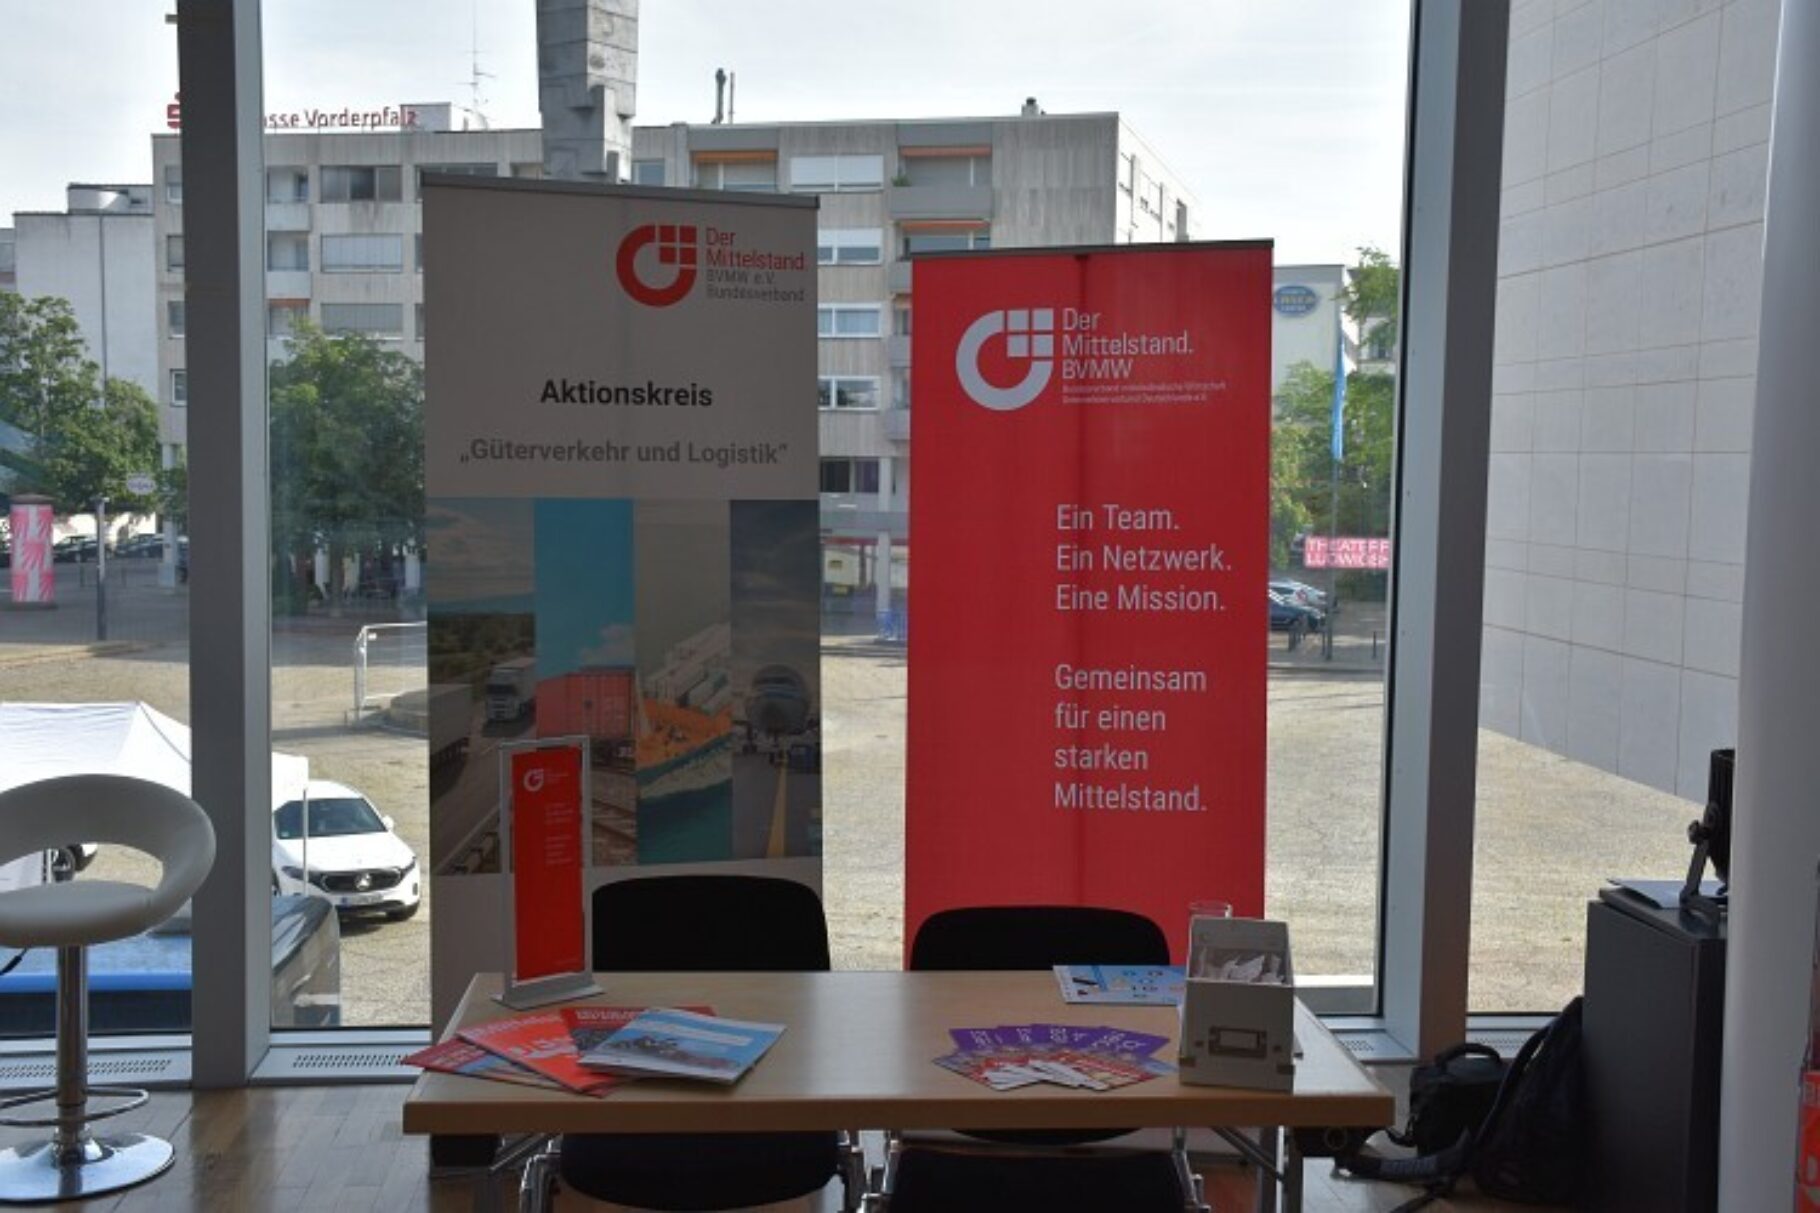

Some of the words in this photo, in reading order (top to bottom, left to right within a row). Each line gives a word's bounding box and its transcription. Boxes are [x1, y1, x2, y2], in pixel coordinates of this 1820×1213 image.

[304, 106, 418, 130] Vorderpfalz
[705, 227, 736, 246] Der
[1062, 307, 1101, 331] Der
[1062, 328, 1195, 357] Mittelstand.
[1062, 358, 1133, 380] BVMW
[541, 378, 713, 406] Aktionskreis
[637, 440, 680, 462] und
[1056, 503, 1094, 531] Ein
[1102, 503, 1180, 531] Team.
[1056, 544, 1094, 571] Ein
[1103, 543, 1232, 571] Netzwerk.
[1056, 584, 1108, 611] Eine
[1117, 584, 1227, 611] Mission.
[1055, 663, 1207, 692] Gemeinsam
[1055, 702, 1090, 730] für
[1097, 705, 1167, 731] einen
[1054, 742, 1149, 770] starken
[1054, 781, 1208, 812] Mittelstand.
